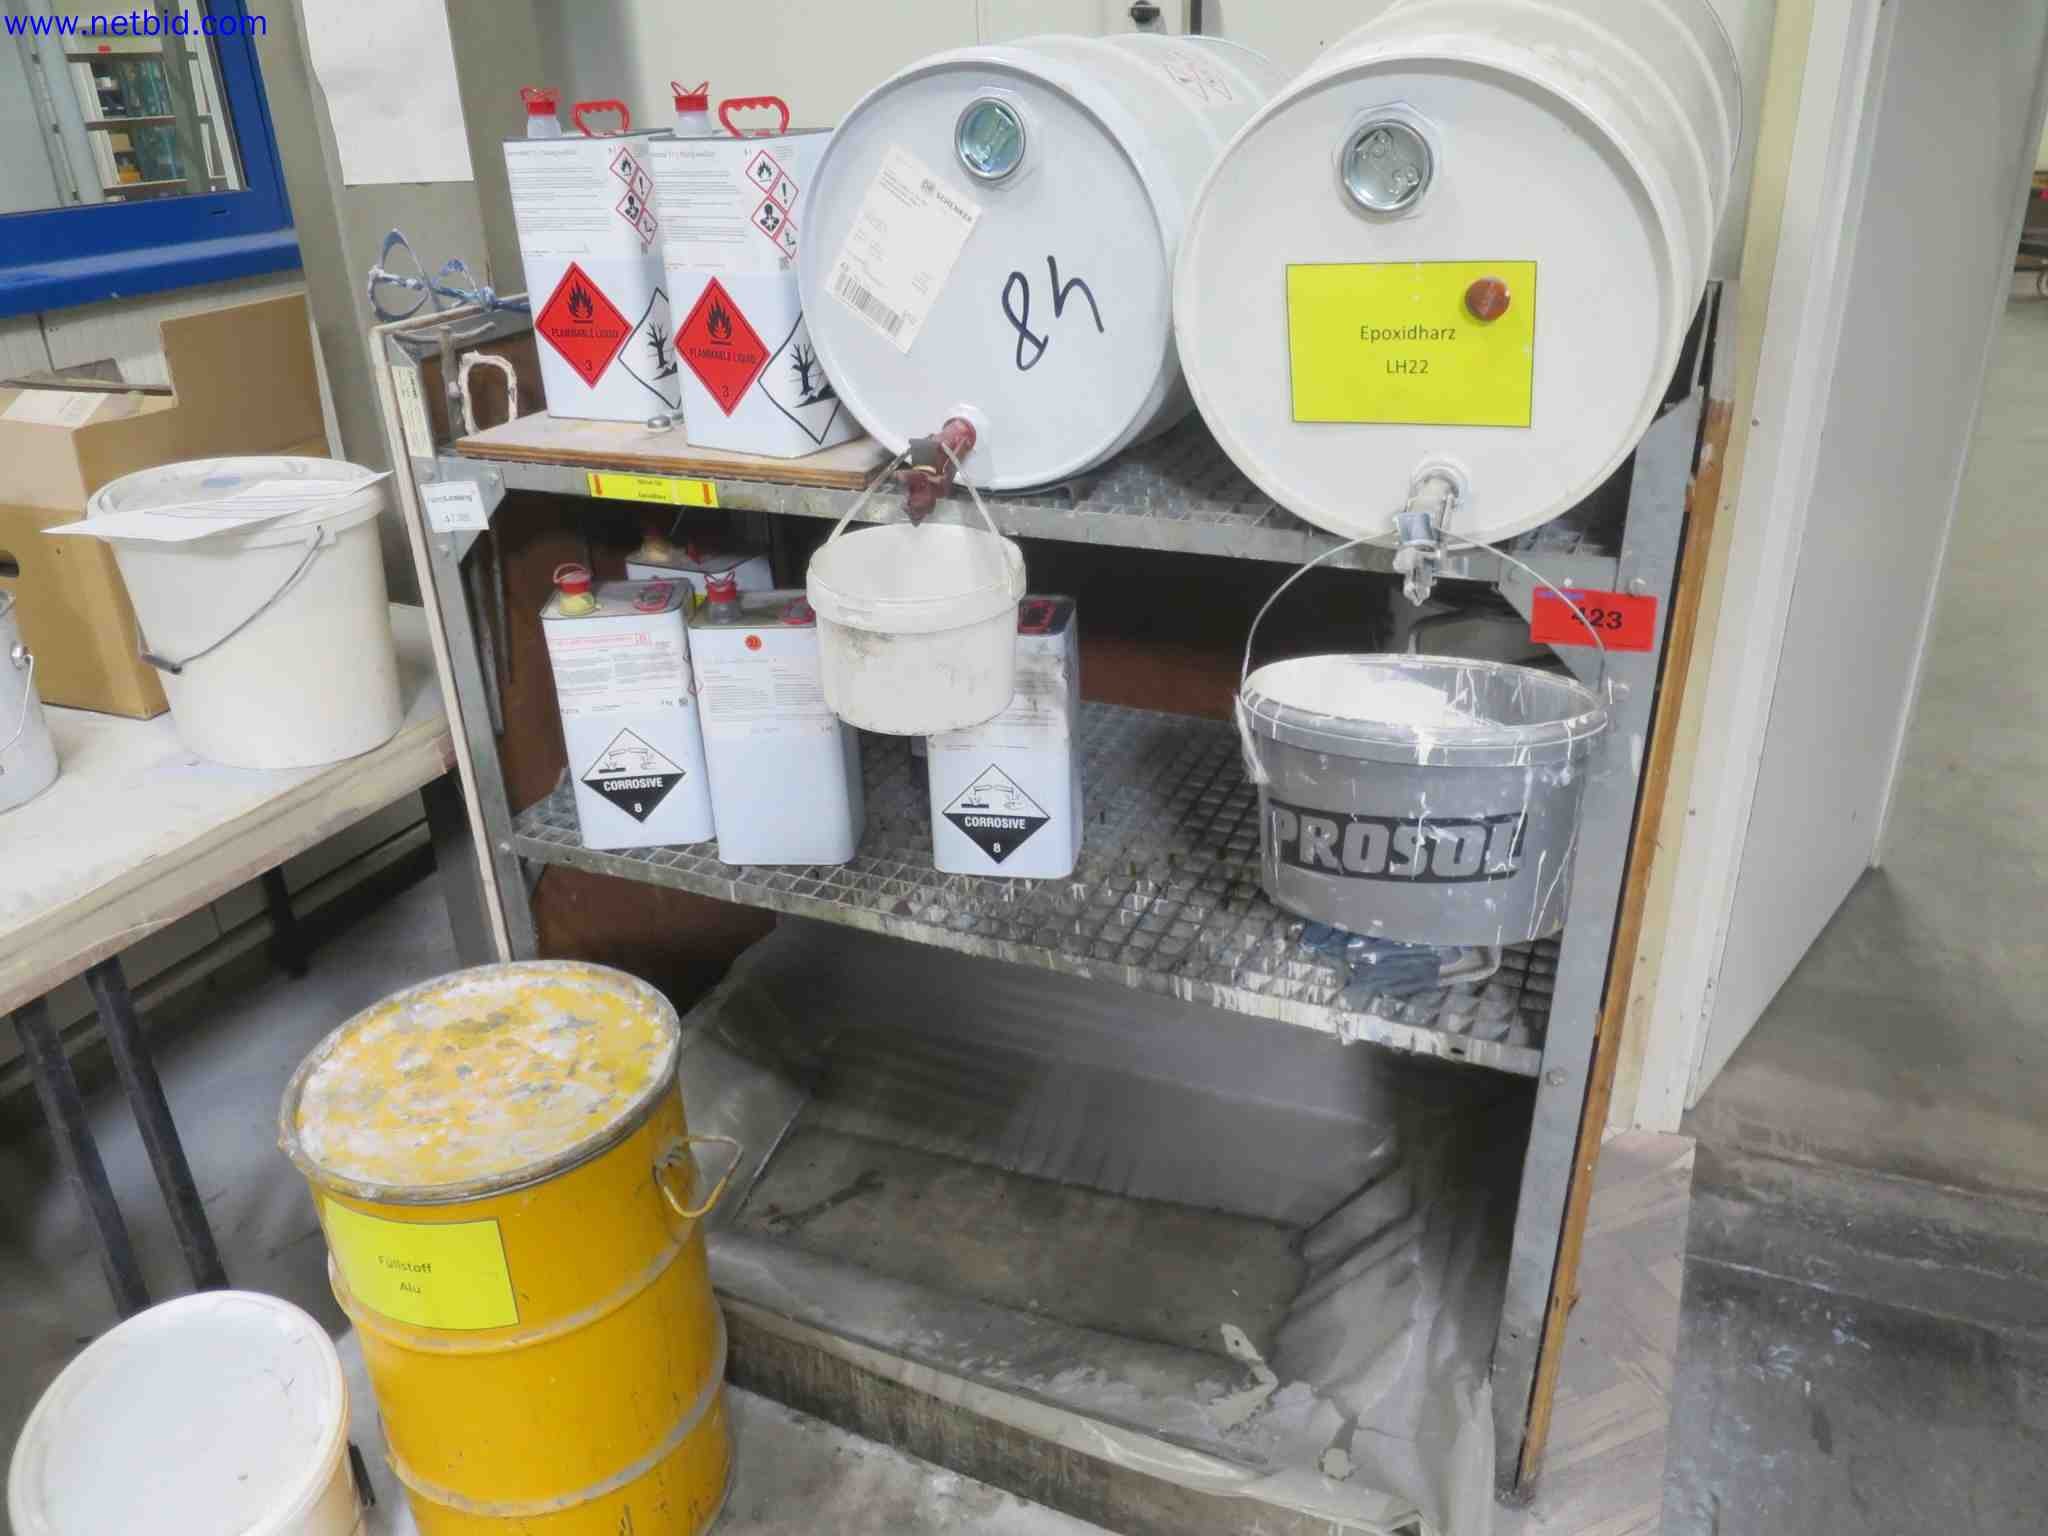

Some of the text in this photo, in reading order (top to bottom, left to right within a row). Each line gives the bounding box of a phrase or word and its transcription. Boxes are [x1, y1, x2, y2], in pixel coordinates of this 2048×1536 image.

[1360, 324, 1456, 344] Epoxidharz
[584, 360, 593, 372] 3
[1386, 359, 1429, 374] LH22
[721, 386, 730, 398] 3
[603, 777, 664, 792] CORROSIVE
[964, 816, 1026, 830] CORROSIVE
[993, 841, 1001, 853] 8
